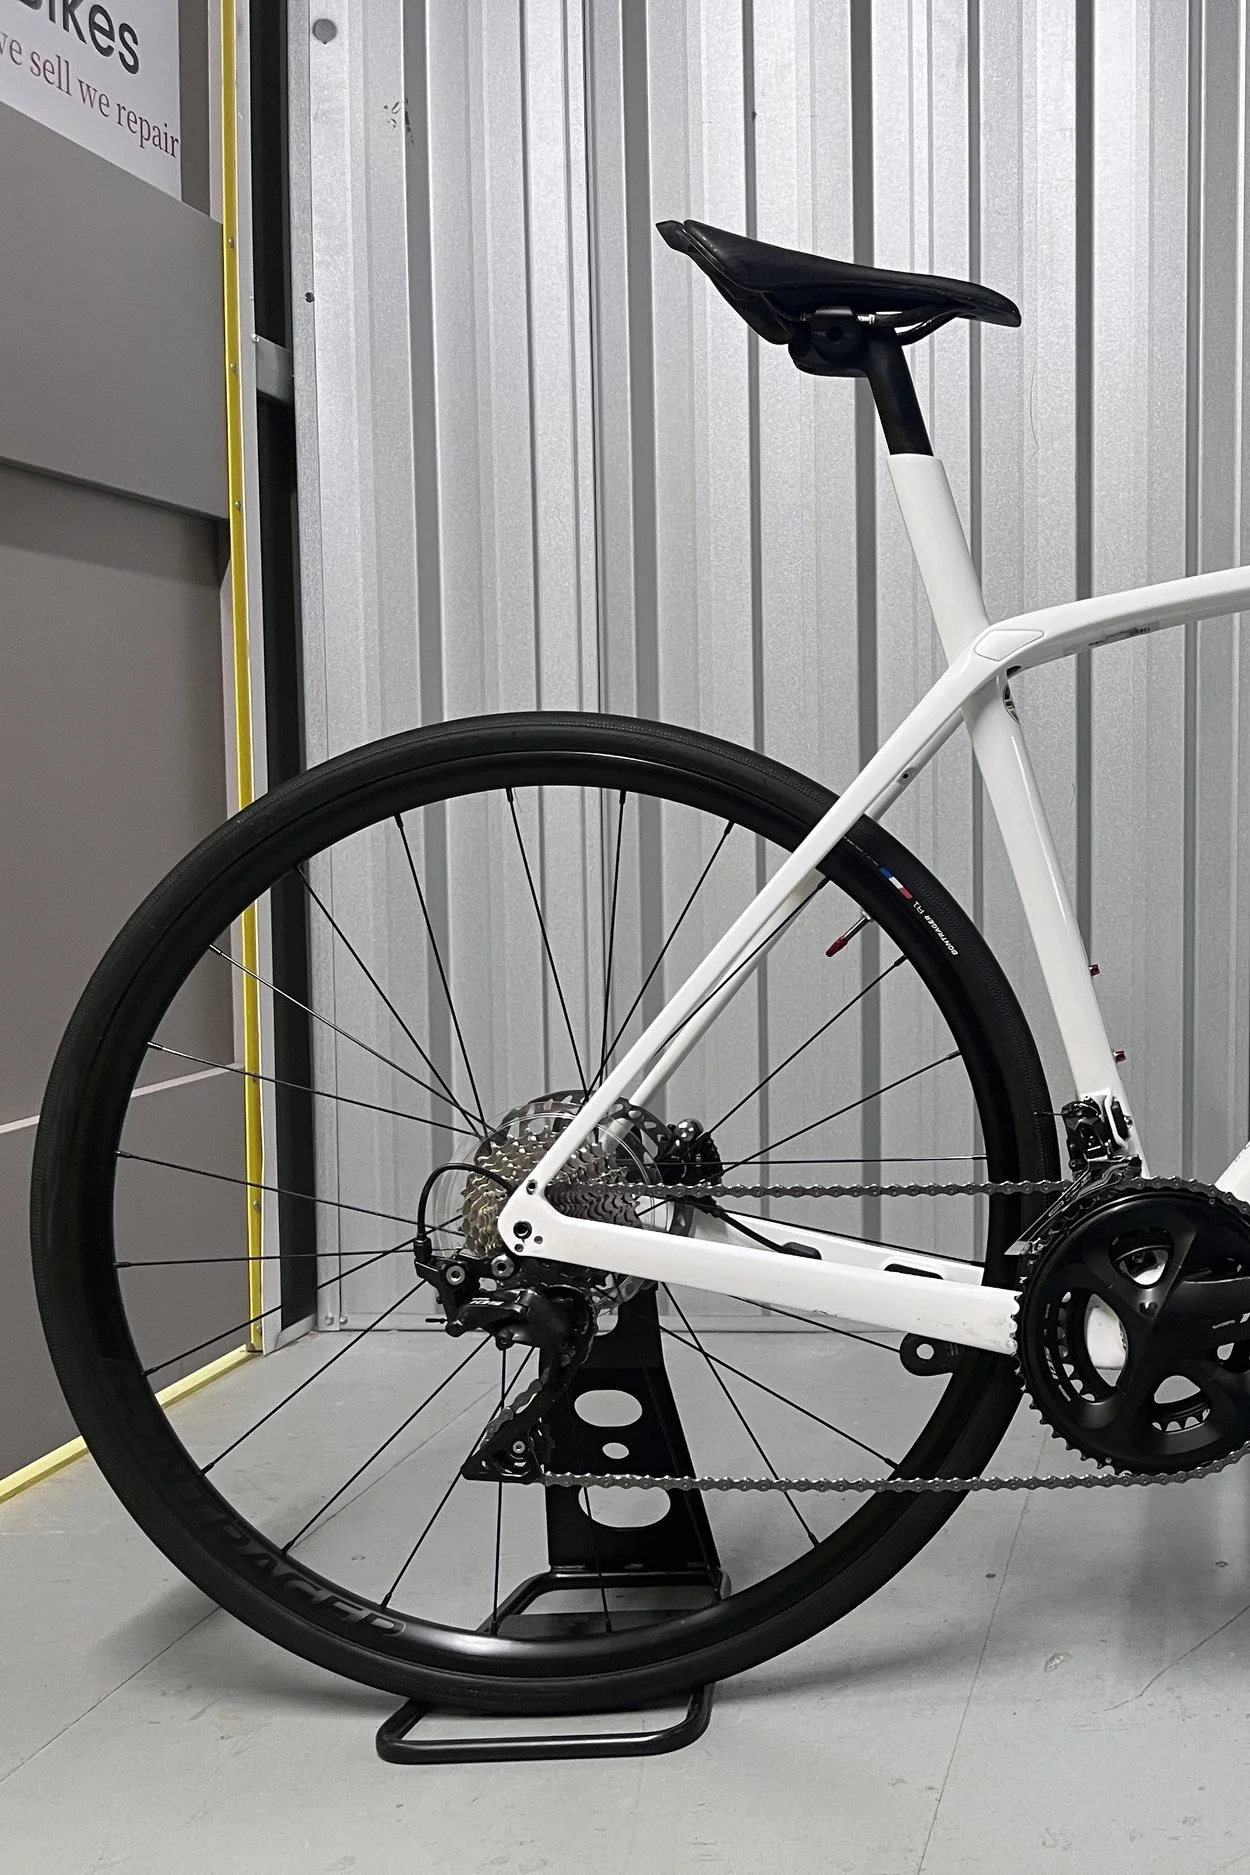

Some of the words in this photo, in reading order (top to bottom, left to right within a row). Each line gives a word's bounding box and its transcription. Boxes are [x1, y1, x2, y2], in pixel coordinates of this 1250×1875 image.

[17, 0, 139, 74] kes
[30, 51, 73, 97] sell
[77, 78, 110, 118] we
[116, 103, 179, 157] repair
[924, 915, 958, 955] BONTRAGER
